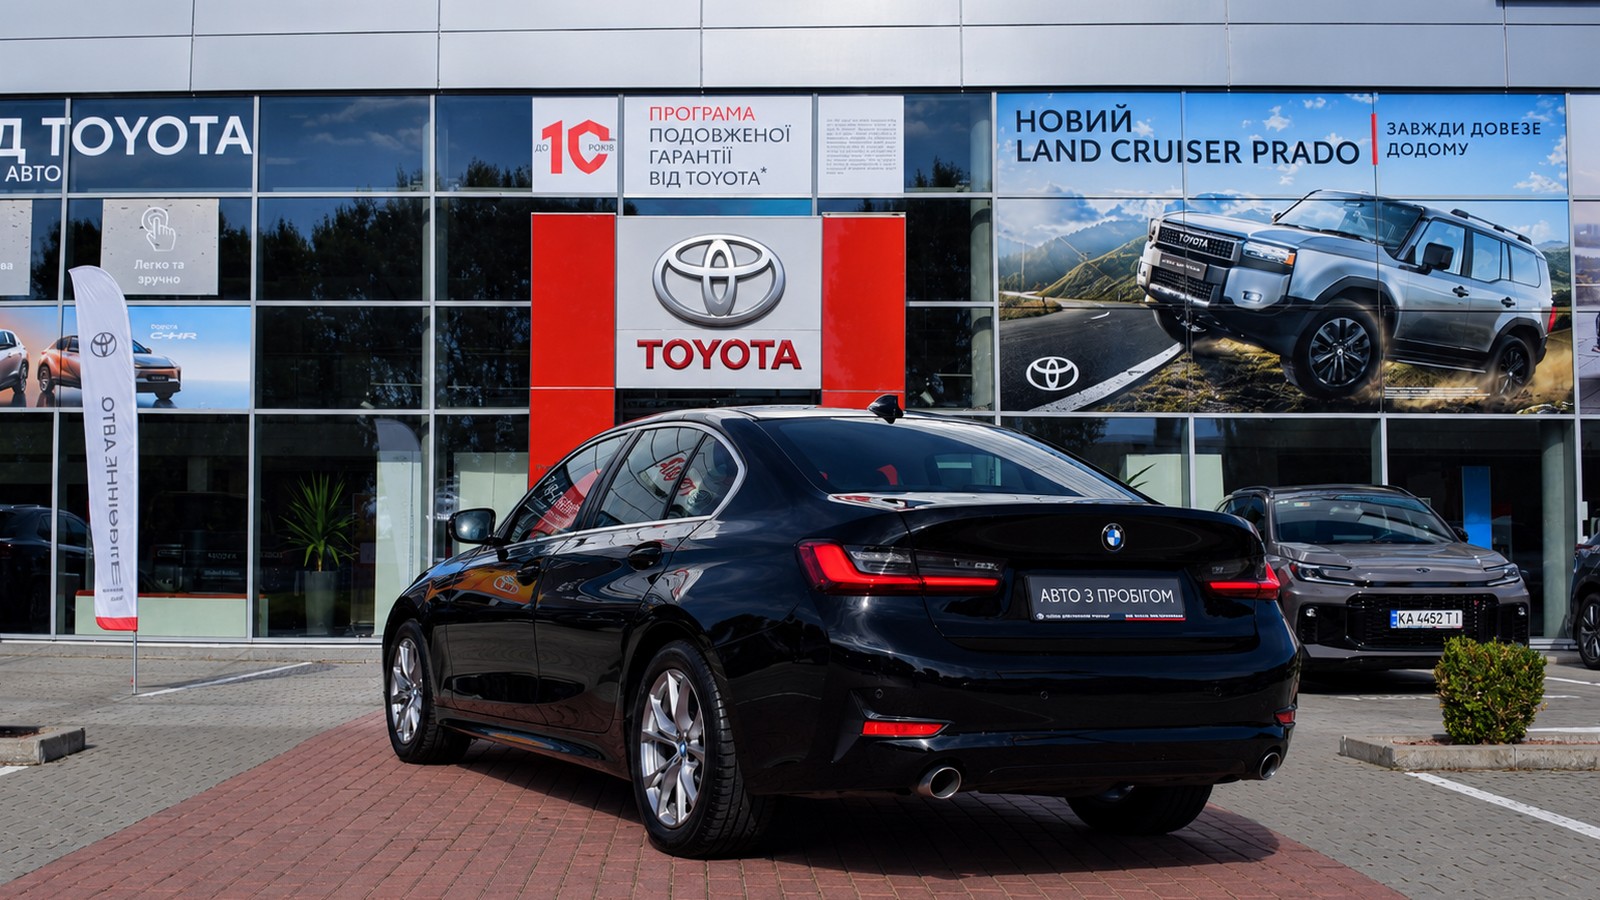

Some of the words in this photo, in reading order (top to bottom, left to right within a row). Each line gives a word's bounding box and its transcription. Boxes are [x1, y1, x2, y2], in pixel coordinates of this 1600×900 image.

[649, 106, 756, 121] ПРОГРАМА
[1015, 104, 1133, 133] НОВИЙ
[41, 115, 253, 156] TOYOTA
[649, 124, 792, 145] ПОДОВЖЕНОЇ
[1386, 121, 1465, 137] ЗАВЖДИ
[1470, 121, 1542, 137] ДОВЕЗЕ
[535, 144, 549, 153] ДО
[588, 143, 615, 152] РОКІВ
[649, 146, 733, 164] ГАРАНТІЇ
[1015, 139, 1102, 163] LAND
[1110, 139, 1243, 164] CRUISER
[1252, 140, 1360, 165] PRADO
[1386, 142, 1469, 158] ДОДОМУ
[4, 165, 62, 183] АВТО
[649, 171, 681, 188] ВІД
[134, 259, 170, 270] Легко
[172, 260, 185, 270] та
[137, 275, 181, 286] зручно
[150, 331, 198, 340] C-HR
[636, 338, 802, 370] TOYOTA
[1040, 588, 1081, 603] АВТО
[1084, 588, 1094, 603] З
[1097, 588, 1175, 604] ПРОБІГОМ
[1398, 612, 1414, 625] KA
[1417, 612, 1443, 625] 4452
